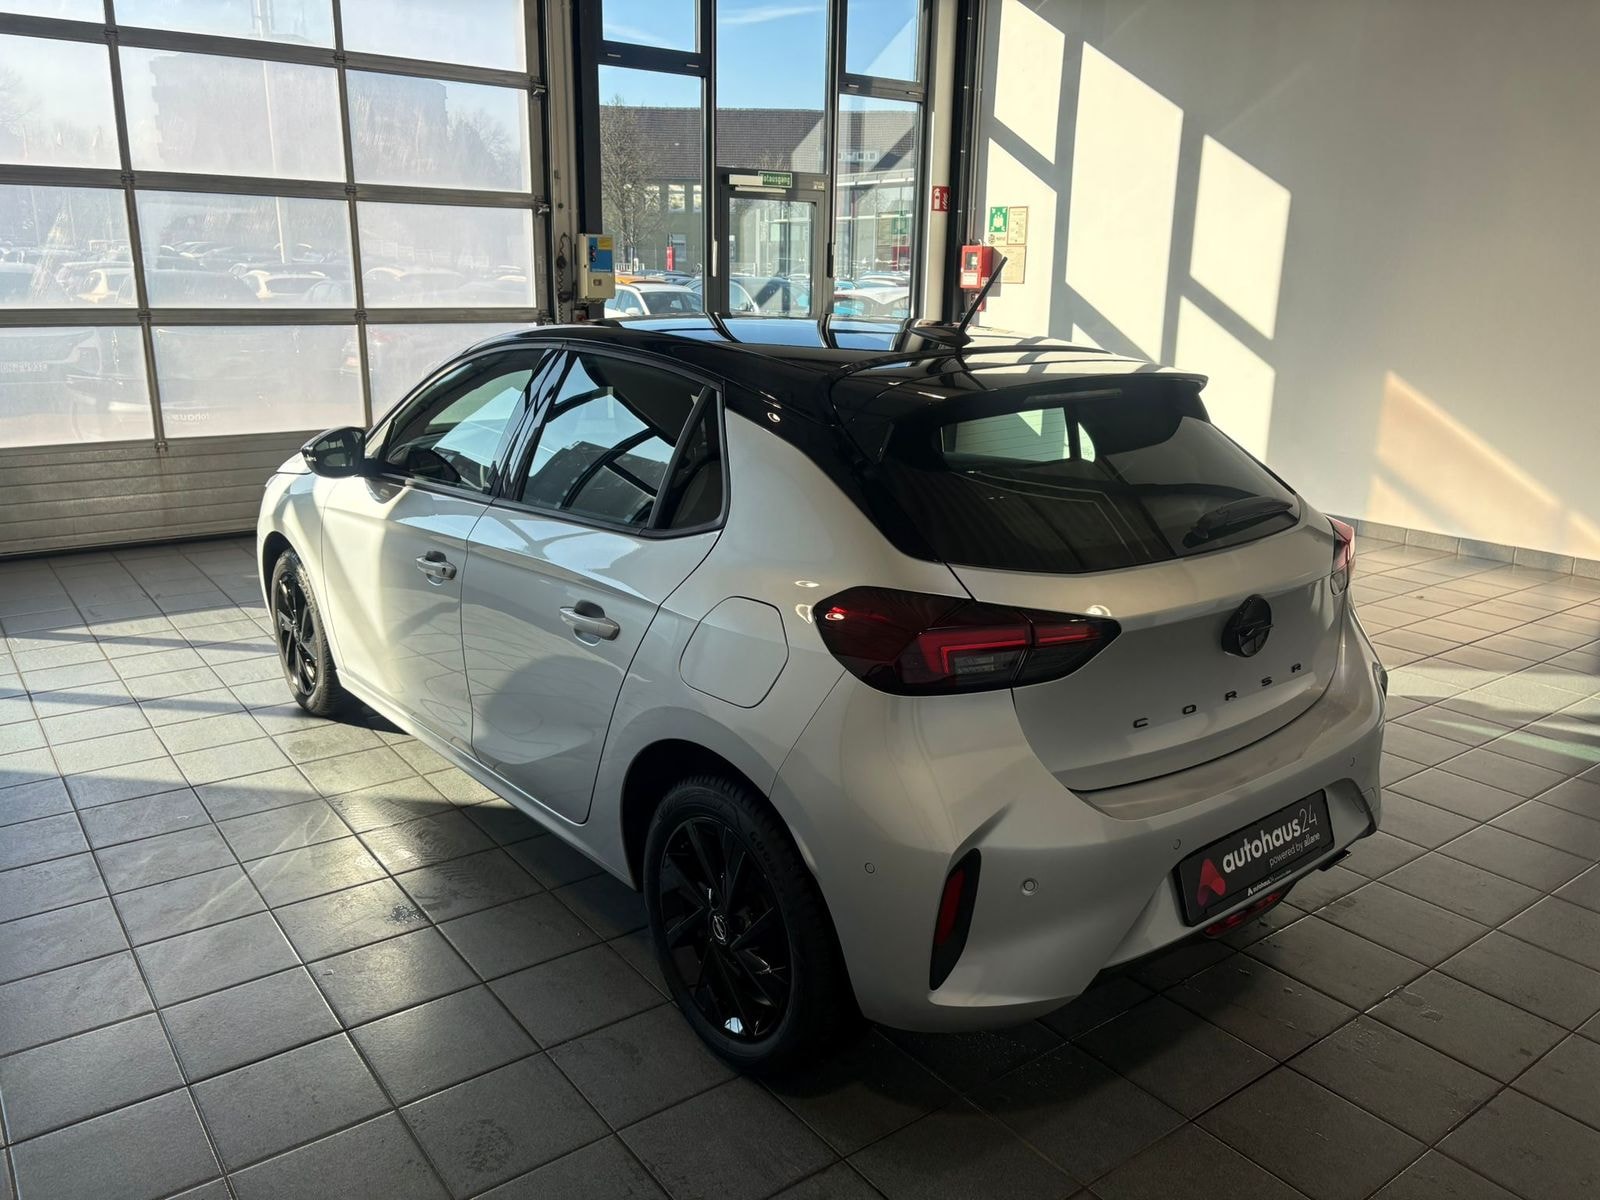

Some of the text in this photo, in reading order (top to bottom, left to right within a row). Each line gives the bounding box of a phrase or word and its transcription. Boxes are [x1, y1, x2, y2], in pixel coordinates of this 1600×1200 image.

[761, 174, 790, 185] otausgang
[1133, 663, 1302, 728] CORSA
[1222, 803, 1318, 874] autohaus24
[1269, 844, 1296, 867] powered
